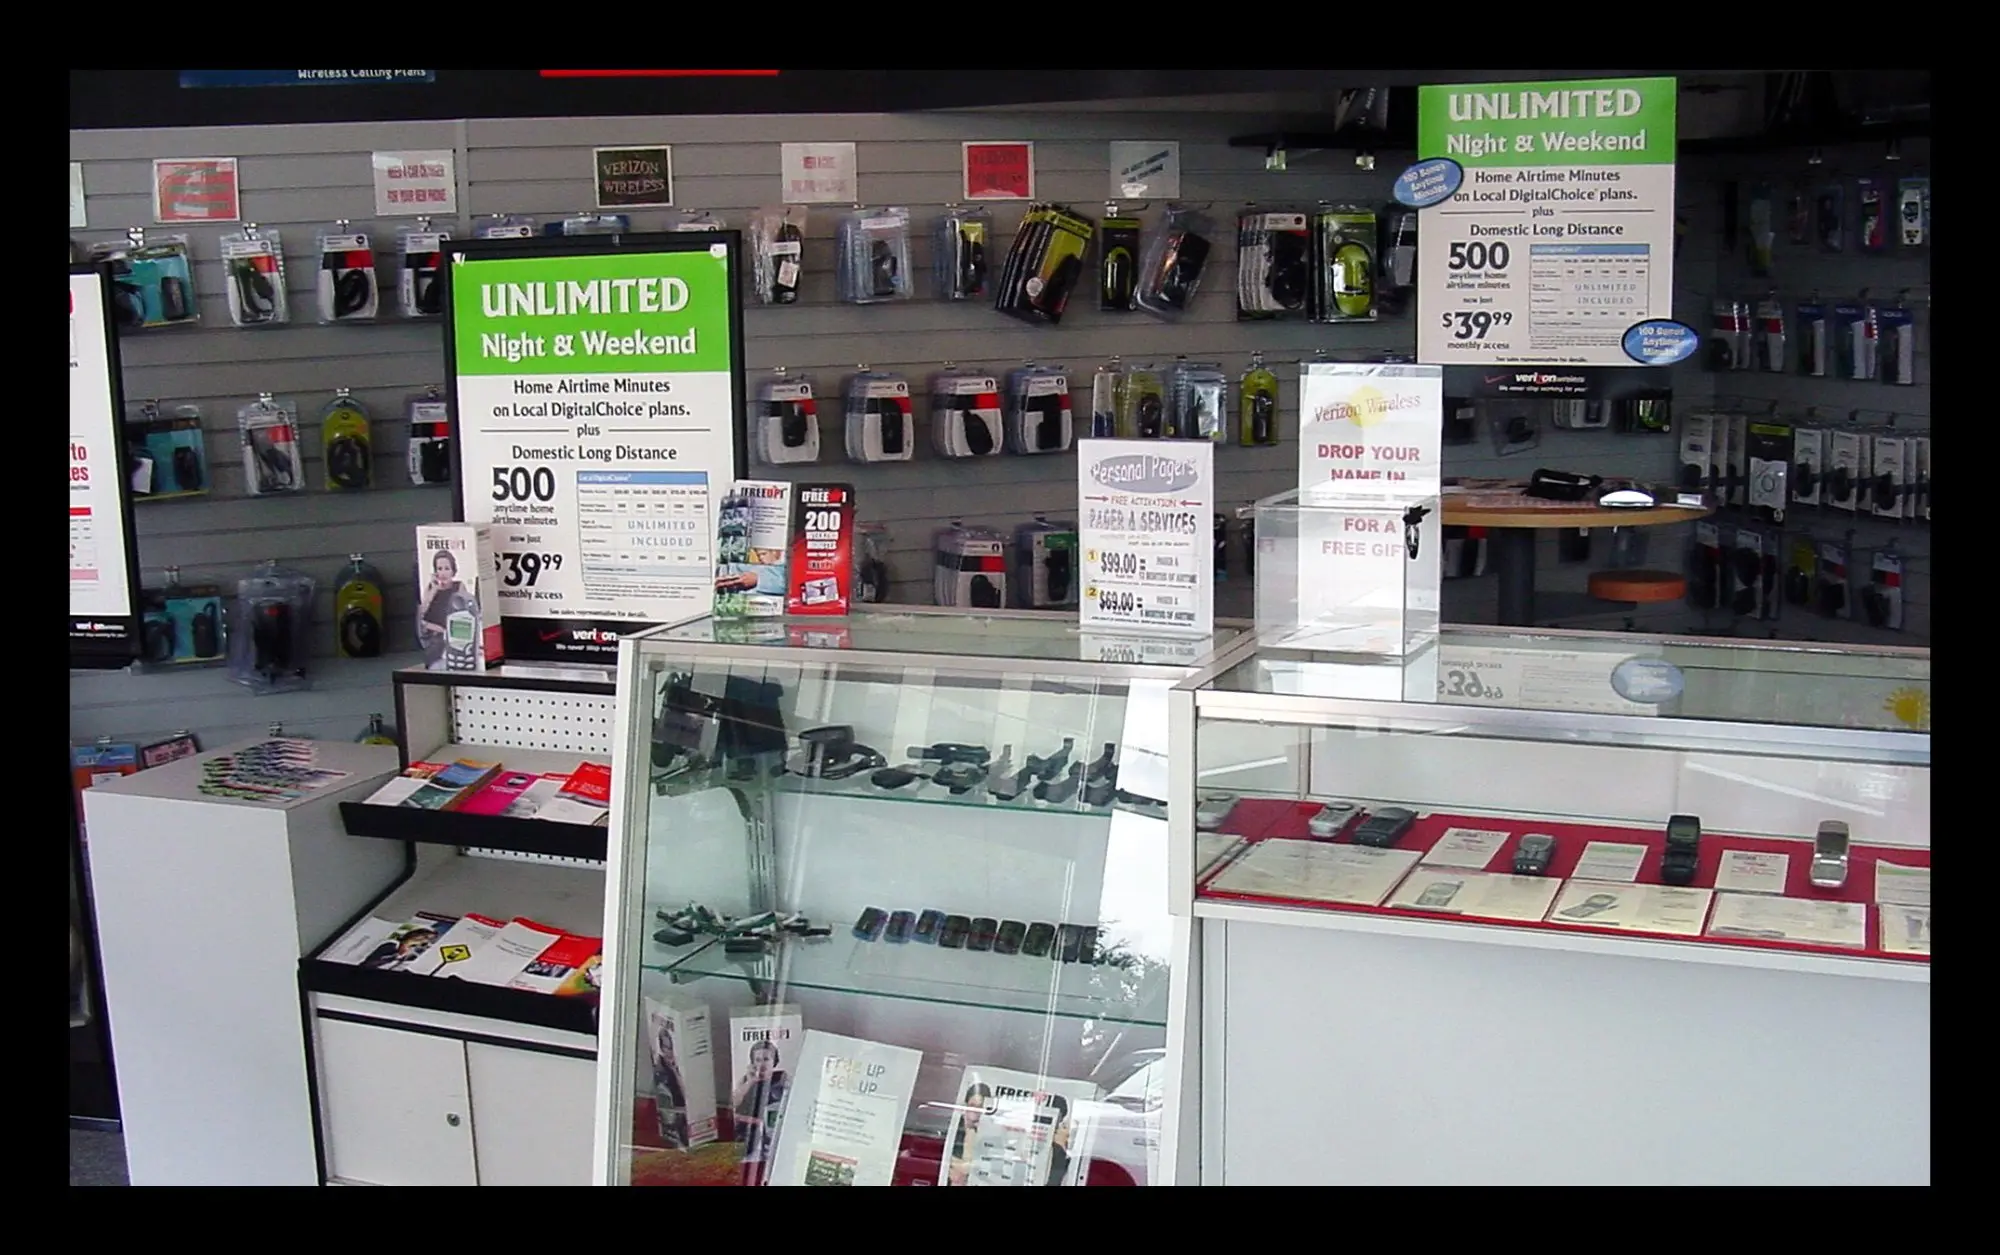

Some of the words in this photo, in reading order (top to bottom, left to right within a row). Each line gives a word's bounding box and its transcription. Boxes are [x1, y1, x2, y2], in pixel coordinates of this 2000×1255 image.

[298, 70, 348, 79] Wireless
[1449, 88, 1642, 121] UNLIMITED
[1447, 133, 1507, 158] Night
[1514, 134, 1535, 152] &
[1541, 129, 1646, 152] Weekend
[603, 160, 659, 176] VERIZON
[1475, 171, 1512, 183] Home
[1516, 170, 1565, 183] Airtime
[1569, 169, 1621, 182] Minutes
[603, 179, 665, 195] WIRELESS
[1453, 193, 1470, 202] on
[1473, 188, 1506, 201] Local
[1599, 187, 1638, 202] plans.
[1532, 206, 1554, 218] plus
[1470, 224, 1529, 237] Domestic
[1533, 223, 1565, 238] Long
[1567, 222, 1624, 236] Distance
[1448, 241, 1510, 270] 500
[1449, 272, 1482, 281] anytime
[1485, 272, 1508, 280] home
[1446, 281, 1475, 289] airtime
[1477, 282, 1511, 290] minutes
[1575, 283, 1637, 292] UNLIMITED
[481, 277, 690, 318] UNLIMITED
[1577, 296, 1634, 305] INCLUDED
[480, 331, 546, 362] Night
[554, 333, 576, 355] &
[580, 327, 697, 355] Weekend
[1447, 341, 1482, 351] monthly
[514, 379, 553, 394] Home
[557, 378, 610, 393] Airtime
[614, 377, 671, 393] Minutes
[493, 406, 509, 417] on
[513, 402, 548, 417] Local
[648, 401, 691, 418] plans.
[1315, 403, 1362, 424] Verizon
[1366, 393, 1422, 415] Wireless
[576, 424, 601, 438] plus
[71, 444, 87, 461] to
[512, 445, 575, 460] Domestic
[578, 444, 612, 461] Long
[615, 445, 677, 460] Distance
[1317, 444, 1365, 460] DROP
[1371, 446, 1421, 462] YOUR
[1091, 455, 1147, 484] Personal
[1151, 456, 1198, 484] Pagers
[1331, 469, 1382, 481] NAME
[1386, 471, 1406, 482] IN
[491, 466, 556, 502] 500
[493, 505, 527, 518] anytime
[529, 504, 555, 514] home
[492, 515, 522, 526] airtime
[523, 516, 559, 527] minutes
[628, 520, 696, 531] UNLIMITED
[805, 511, 842, 531] 200
[1140, 510, 1197, 535] SERVICES
[1344, 518, 1379, 533] FOR
[1384, 520, 1397, 534] A
[510, 535, 525, 543] now
[631, 536, 693, 547] INCLUDED
[1322, 541, 1367, 556] FREE
[1101, 552, 1137, 574] $99.00
[498, 588, 533, 602] monthly
[535, 590, 563, 600] access
[1088, 586, 1096, 597] 2
[1099, 590, 1134, 612] $69.00
[866, 1063, 886, 1078] UP
[857, 1080, 878, 1094] UP
